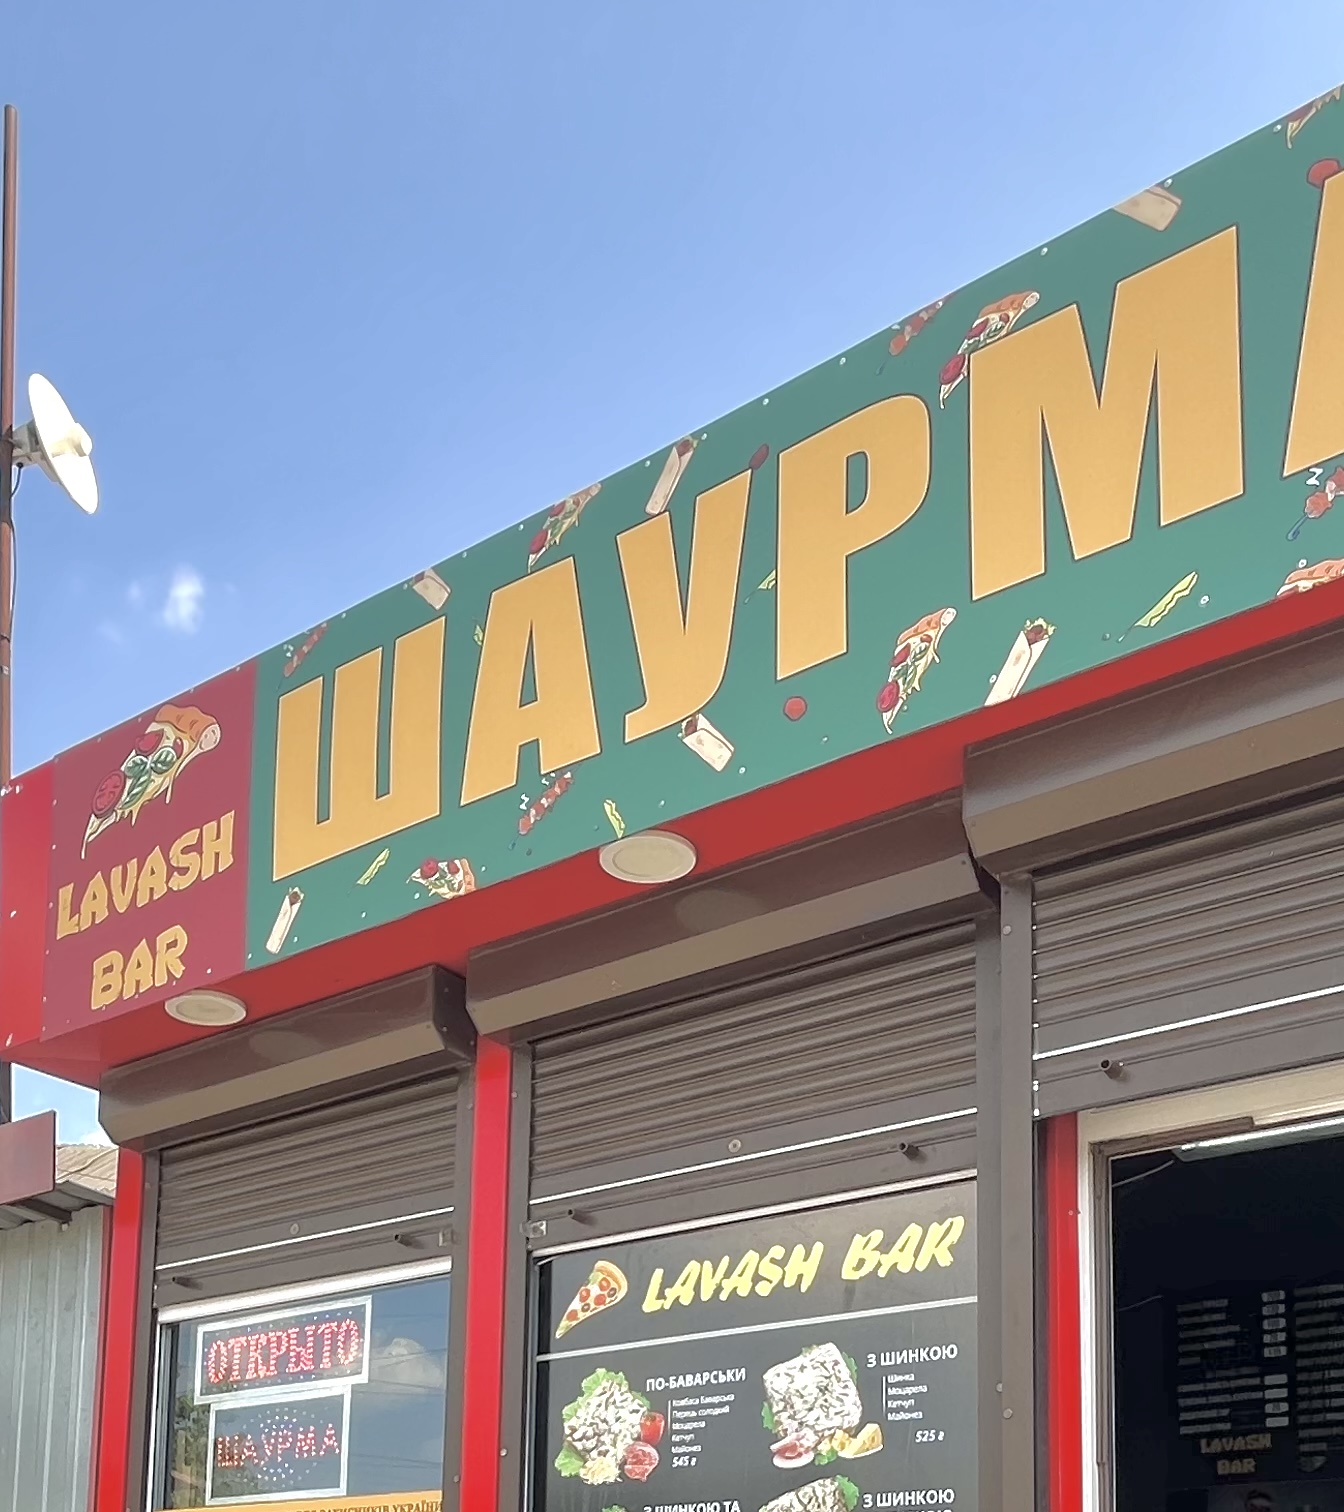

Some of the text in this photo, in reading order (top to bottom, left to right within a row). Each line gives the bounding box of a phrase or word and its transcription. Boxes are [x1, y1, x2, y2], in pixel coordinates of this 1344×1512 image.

[56, 810, 235, 941] LAVASH
[91, 924, 188, 1010] BAR
[642, 1216, 965, 1313] LAVASH BAR
[207, 1318, 359, 1383] ОТКРЫТО
[867, 1344, 958, 1367] З ШИНКОЮ
[646, 1368, 746, 1391] ПО-БАВАРСЬКИ
[217, 1423, 340, 1467] ШАУРМА
[915, 1430, 935, 1442] 525
[863, 1489, 954, 1507] З ШИНКОЮ
